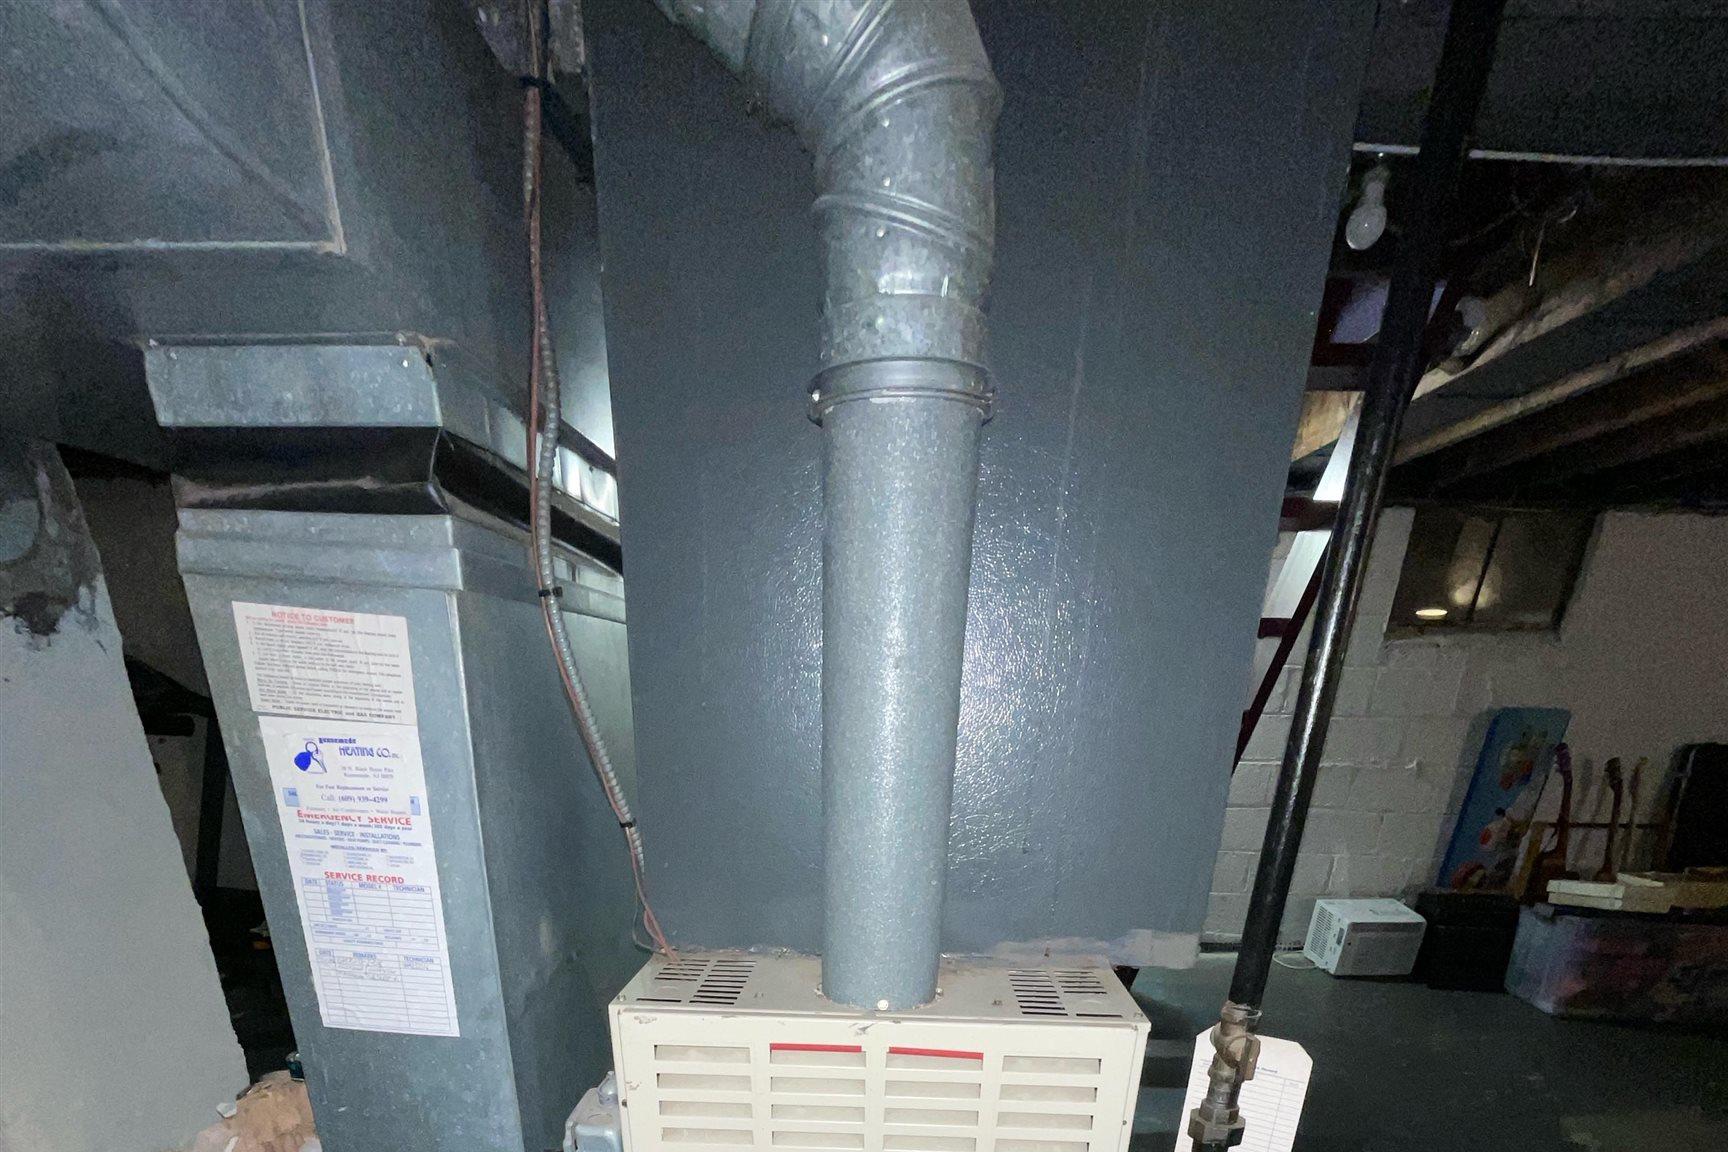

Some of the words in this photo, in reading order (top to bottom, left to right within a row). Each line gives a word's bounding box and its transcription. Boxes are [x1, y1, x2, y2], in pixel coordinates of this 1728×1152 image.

[302, 613, 312, 621] TO
[313, 614, 354, 625] CUSTOMER
[339, 746, 375, 757] HEATING
[297, 809, 363, 822] EMERGENCY
[367, 815, 412, 826] SERVICE
[324, 870, 364, 882] SERVICE
[366, 874, 405, 885] RECORD
